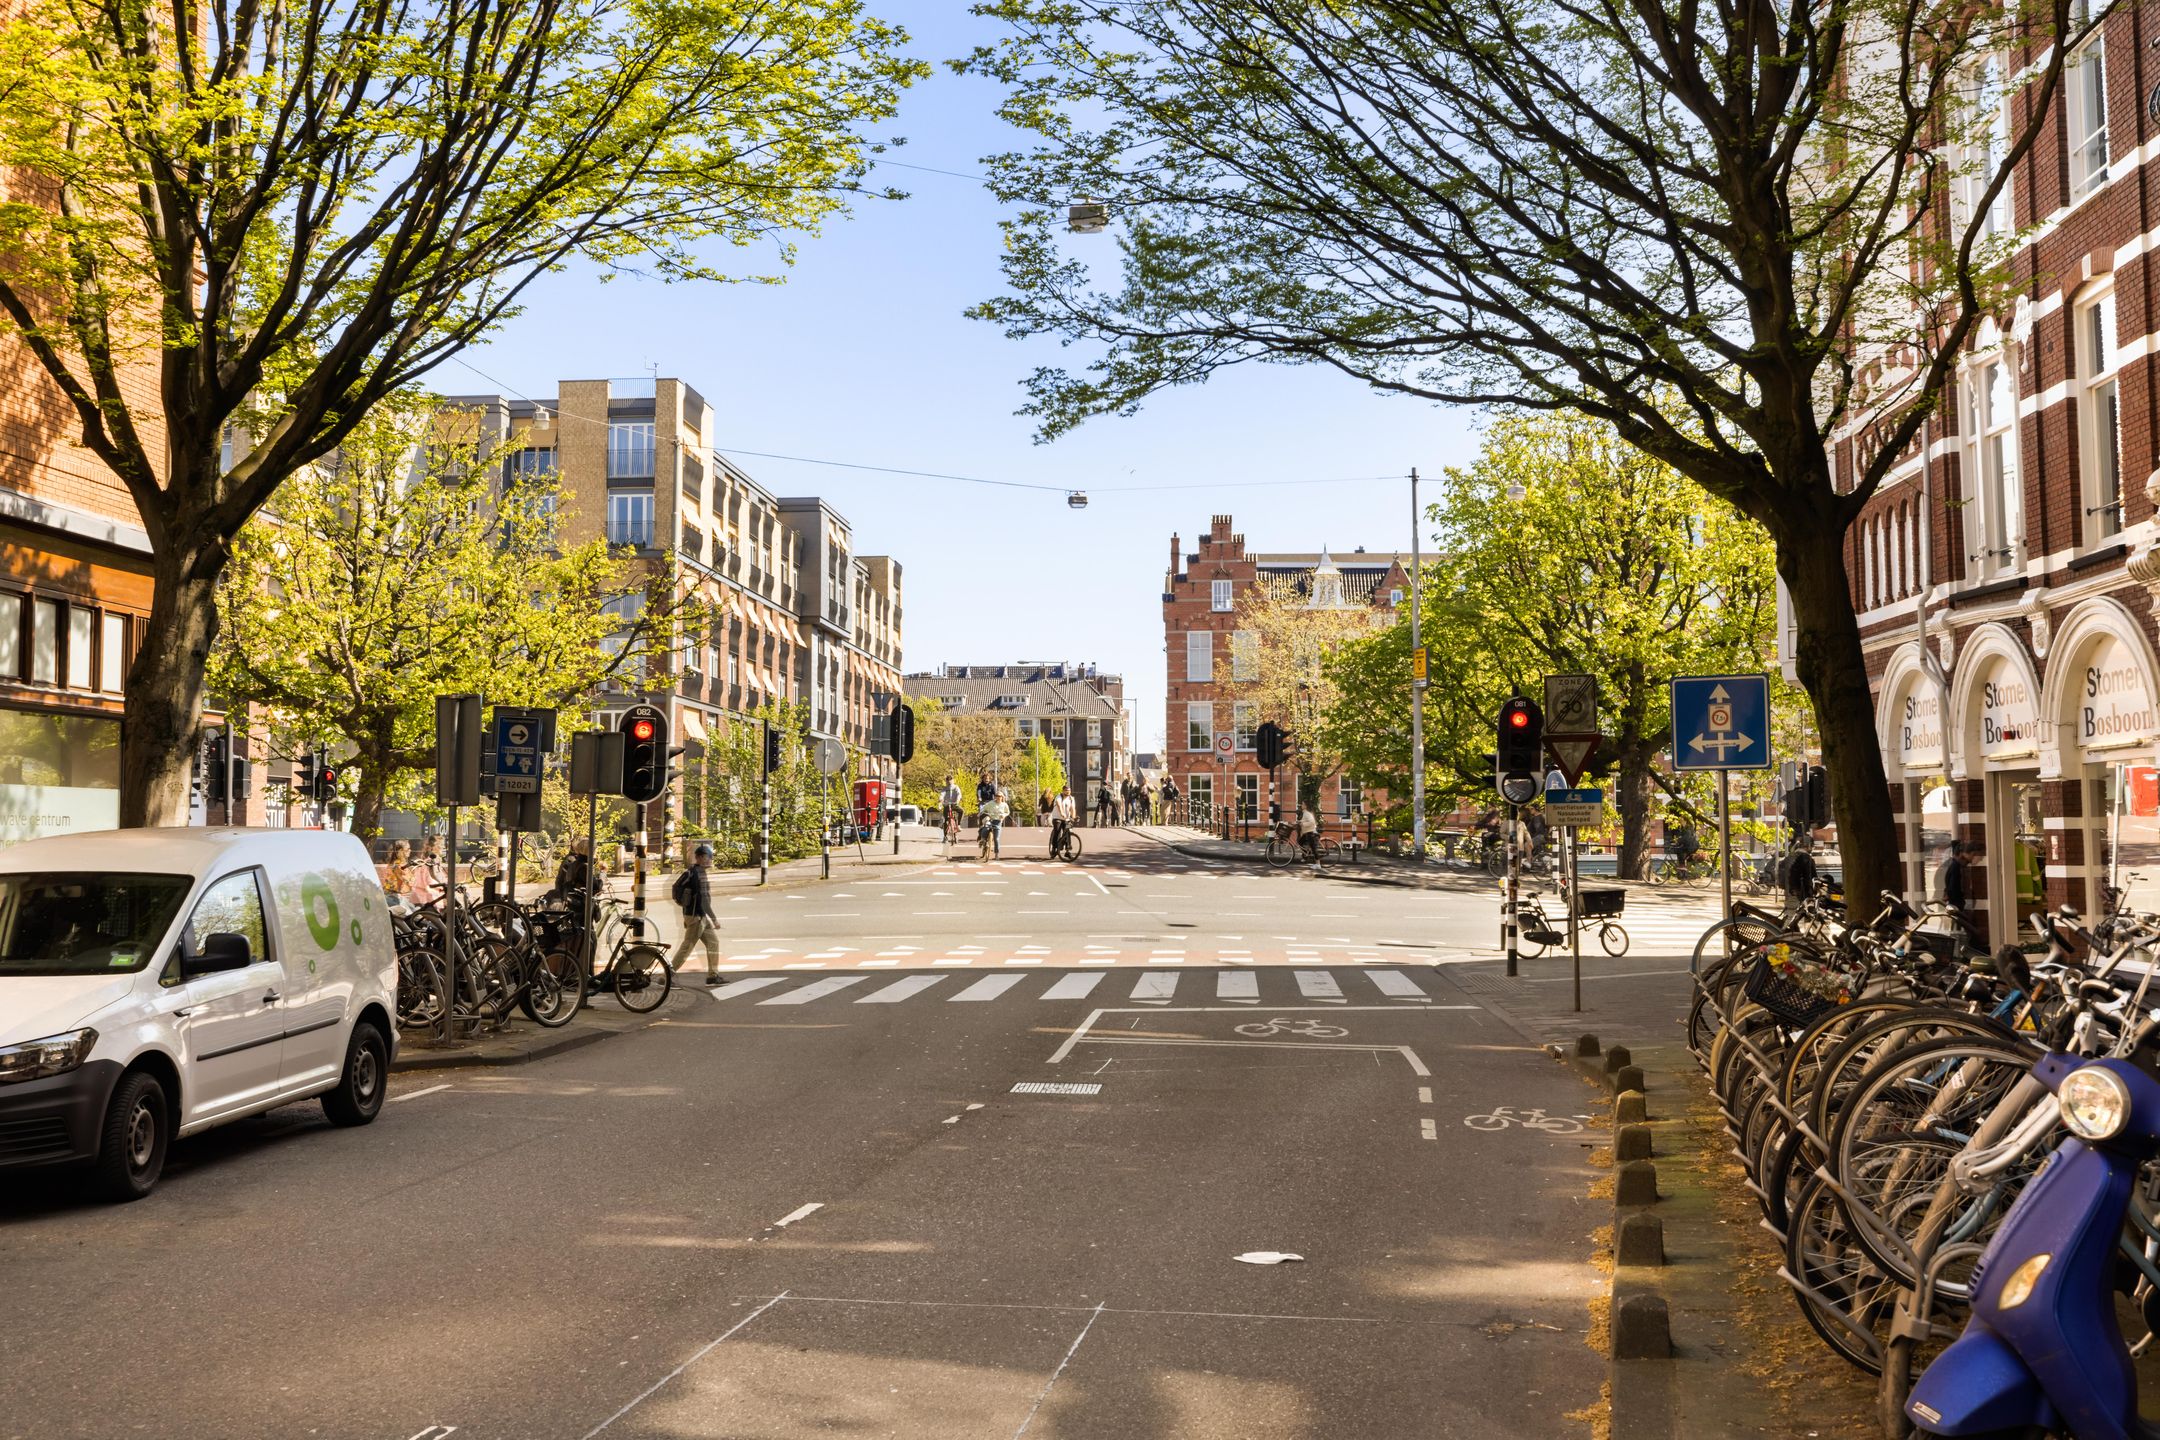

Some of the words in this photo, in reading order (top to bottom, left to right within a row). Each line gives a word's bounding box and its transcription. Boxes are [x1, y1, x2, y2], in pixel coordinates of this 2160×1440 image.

[1558, 678, 1582, 686] ZONE
[1514, 700, 1526, 708] 081
[1560, 700, 1583, 713] 30
[636, 708, 651, 716] 082
[507, 781, 532, 790] 12021
